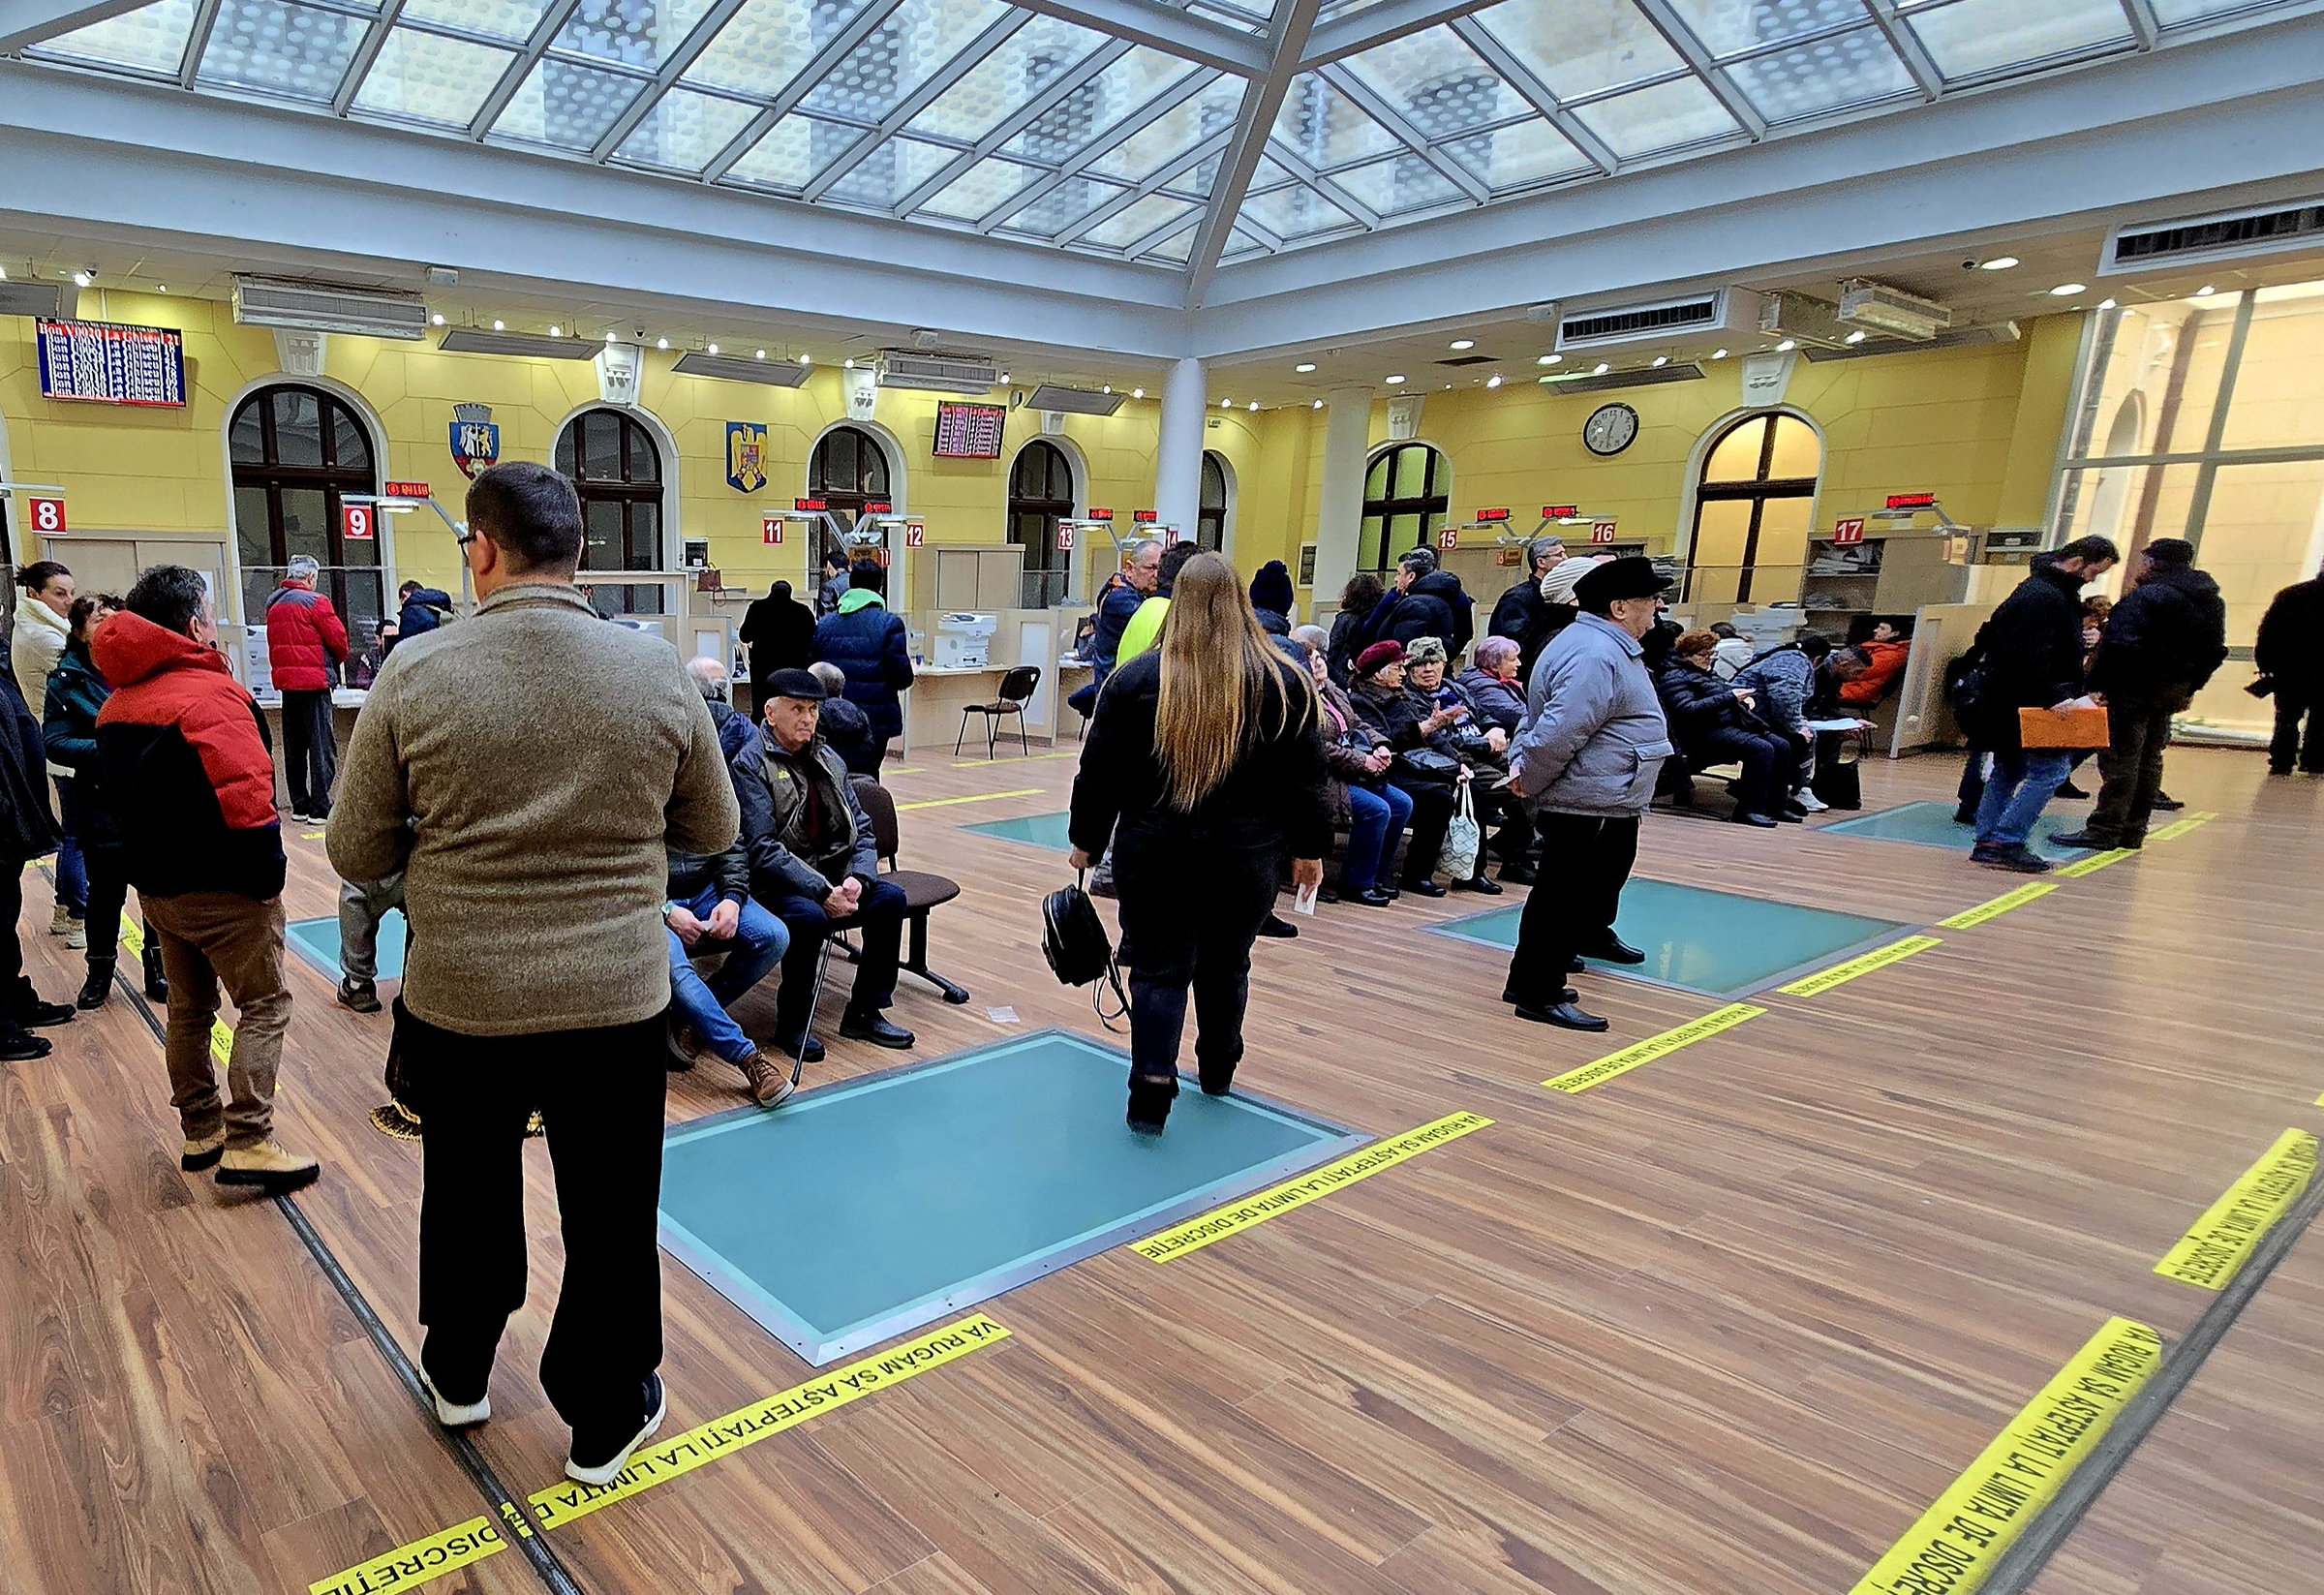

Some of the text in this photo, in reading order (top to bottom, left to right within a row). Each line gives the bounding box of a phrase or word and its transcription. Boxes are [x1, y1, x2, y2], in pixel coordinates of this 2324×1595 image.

[38, 502, 59, 530] 8
[350, 509, 366, 536] 9
[766, 521, 781, 542] 11
[907, 526, 923, 546] 12
[1059, 527, 1073, 547] 13
[1439, 532, 1455, 548] 15
[1595, 523, 1613, 542] 16
[1838, 521, 1862, 541] 17
[879, 549, 890, 566] 11
[1300, 1179, 1330, 1191] LA
[1251, 1187, 1308, 1212] LIMITA
[1227, 1209, 1259, 1222] DE
[1140, 1217, 1235, 1259] DISCREȚIE
[962, 1321, 1001, 1340] VĂ
[877, 1334, 966, 1375] RUGĂM
[839, 1368, 878, 1392] SĂ
[699, 1383, 839, 1450] AȘTEPTAȚI
[656, 1444, 699, 1466] LA
[2002, 1452, 2054, 1478] LA
[1963, 1472, 2036, 1522] LIMITA
[1942, 1515, 1999, 1549] DE
